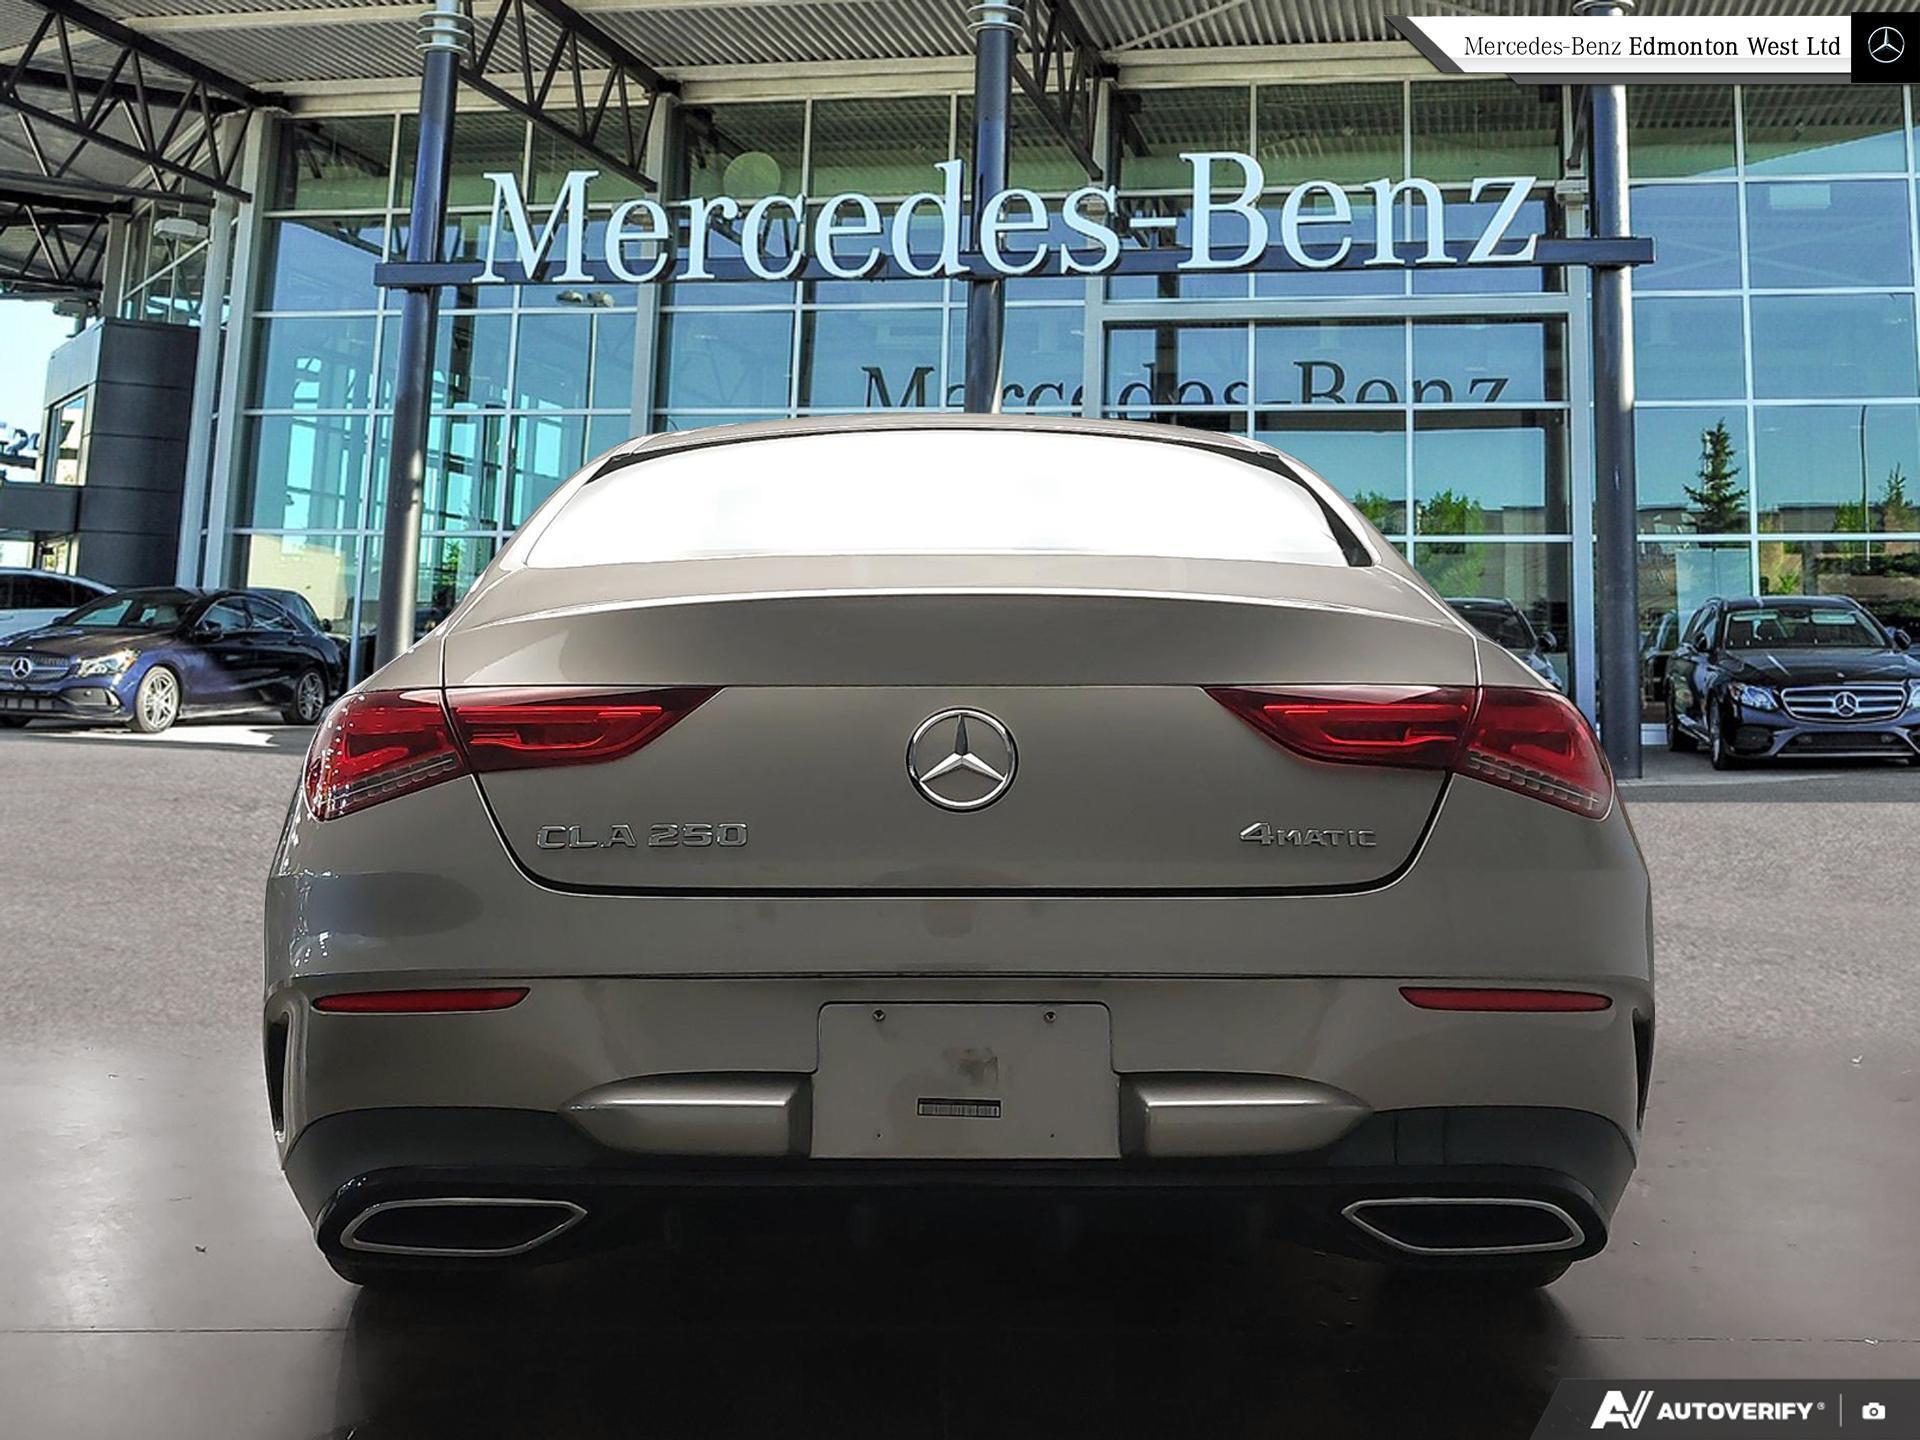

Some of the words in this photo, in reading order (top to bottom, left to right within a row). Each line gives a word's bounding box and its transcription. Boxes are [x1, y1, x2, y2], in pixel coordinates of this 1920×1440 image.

[472, 151, 1538, 283] Mercedes-Benz
[536, 823, 638, 849] CLA
[647, 822, 748, 848] 250
[1239, 821, 1377, 847] 4MATIC
